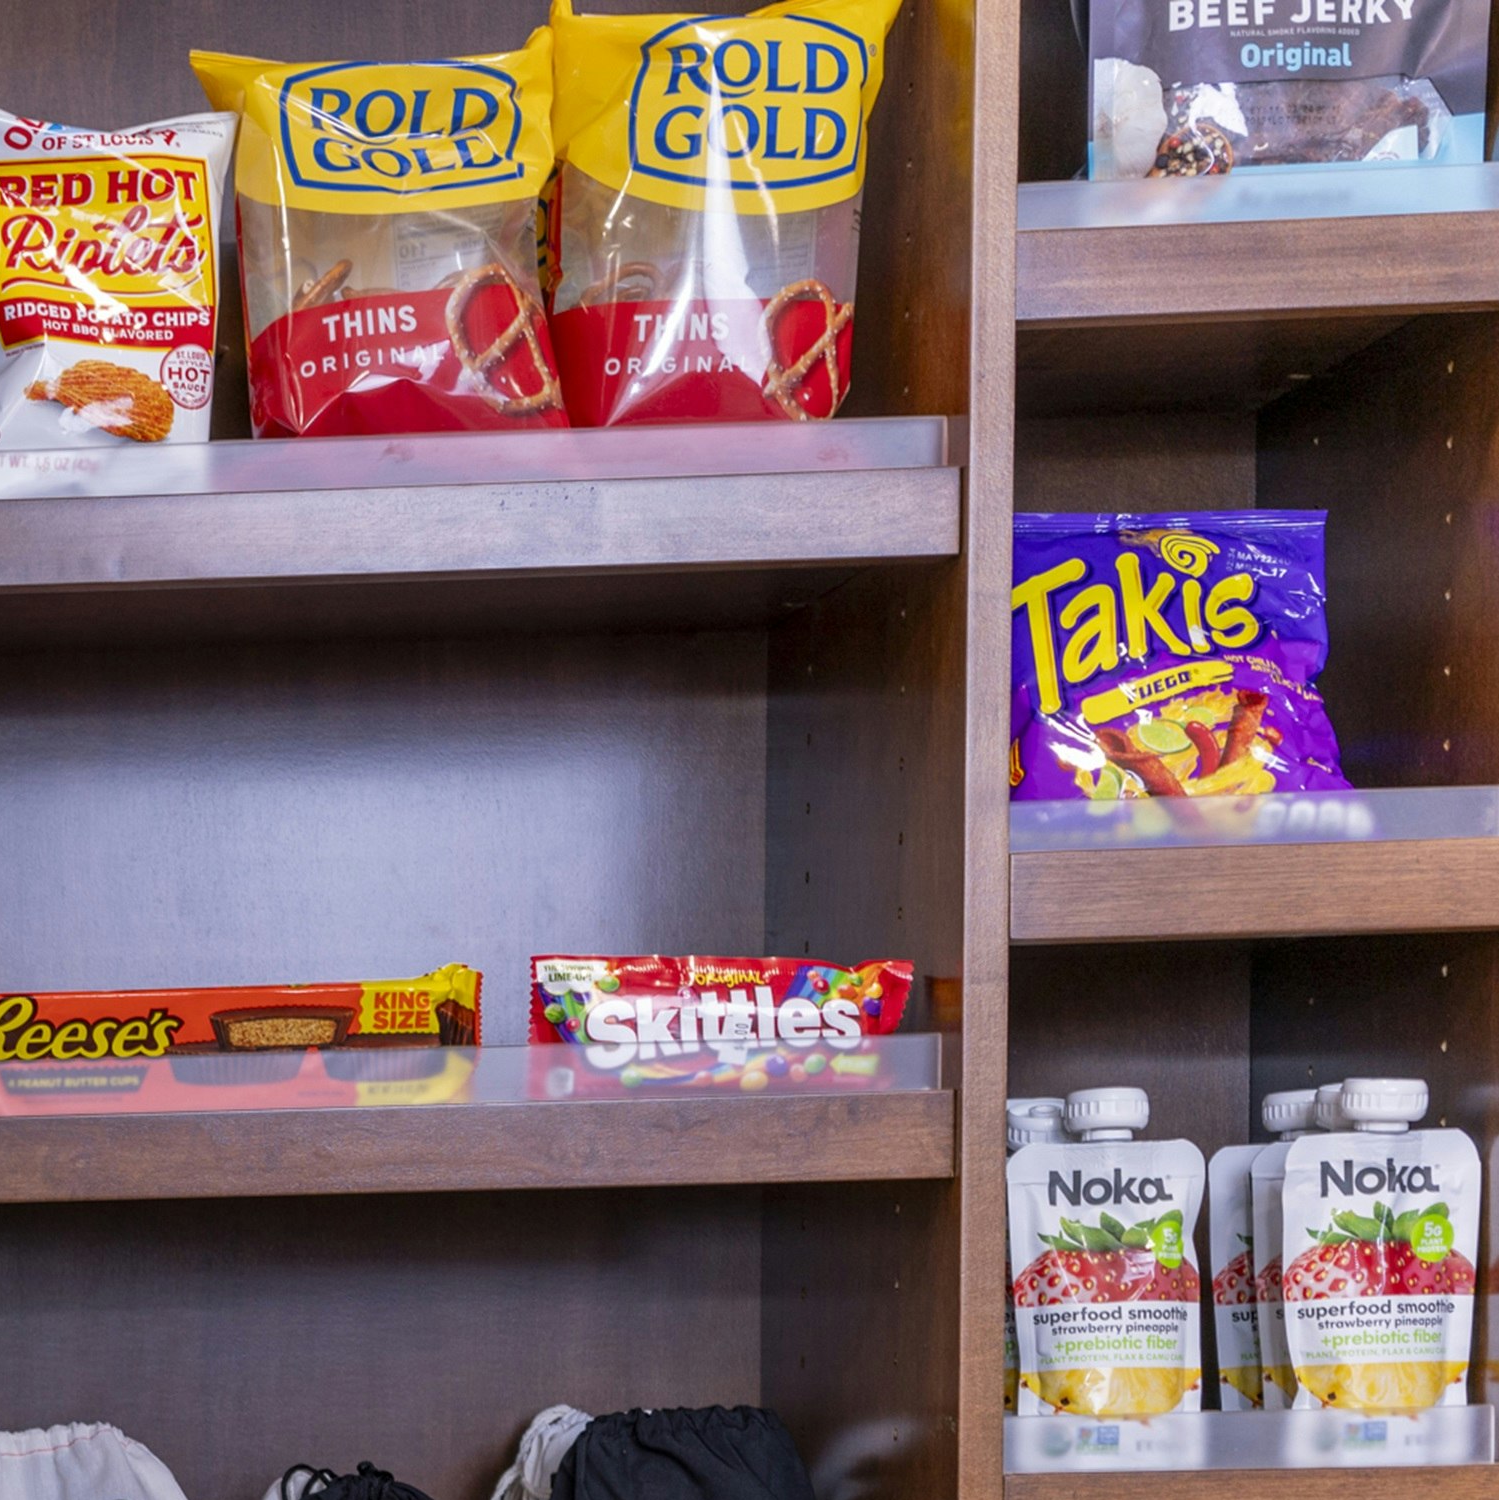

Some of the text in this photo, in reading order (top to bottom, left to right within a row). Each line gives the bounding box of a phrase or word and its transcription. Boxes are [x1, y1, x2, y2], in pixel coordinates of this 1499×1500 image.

[1169, 0, 1415, 31] BEEF JERKY
[1230, 28, 1265, 38] NATURAL
[1267, 27, 1295, 37] SMOKE
[1337, 27, 1360, 36] ADDED
[1240, 41, 1352, 71] Original
[663, 38, 850, 99] ROLD
[309, 87, 500, 146] ROLD
[42, 136, 67, 150] OF
[654, 104, 848, 161] GOLD
[313, 135, 504, 180] GOLD
[107, 168, 200, 204] HOT
[2, 205, 207, 284] Riplets
[4, 302, 71, 322] RIDGED
[152, 311, 211, 327] CHIPS
[322, 305, 418, 342] THINS
[42, 319, 99, 336] HOT BBQ
[301, 343, 445, 379] ORIGINAL
[604, 354, 754, 376] ORGINAL
[168, 366, 210, 384] HOT
[173, 382, 206, 392] SAUCE
[1011, 534, 1260, 714] Takis
[695, 969, 765, 988] ORIGINAL
[374, 992, 430, 1010] KING
[373, 1011, 430, 1031] SIZE
[585, 987, 862, 1072] Skittles
[17, 1075, 140, 1089] PEANUT BUTTER CUPS
[1048, 1169, 1173, 1206] Noka
[1320, 1158, 1440, 1198] Noka
[1033, 1305, 1188, 1327] superfood smoothie
[1297, 1299, 1455, 1322] superfood smoothie
[1051, 1323, 1179, 1337] strawberry pineapple
[1317, 1314, 1443, 1331] strawberry pineapple
[1054, 1334, 1178, 1354] +prebiotic fiber
[1321, 1328, 1442, 1348] +prebiotic fiber
